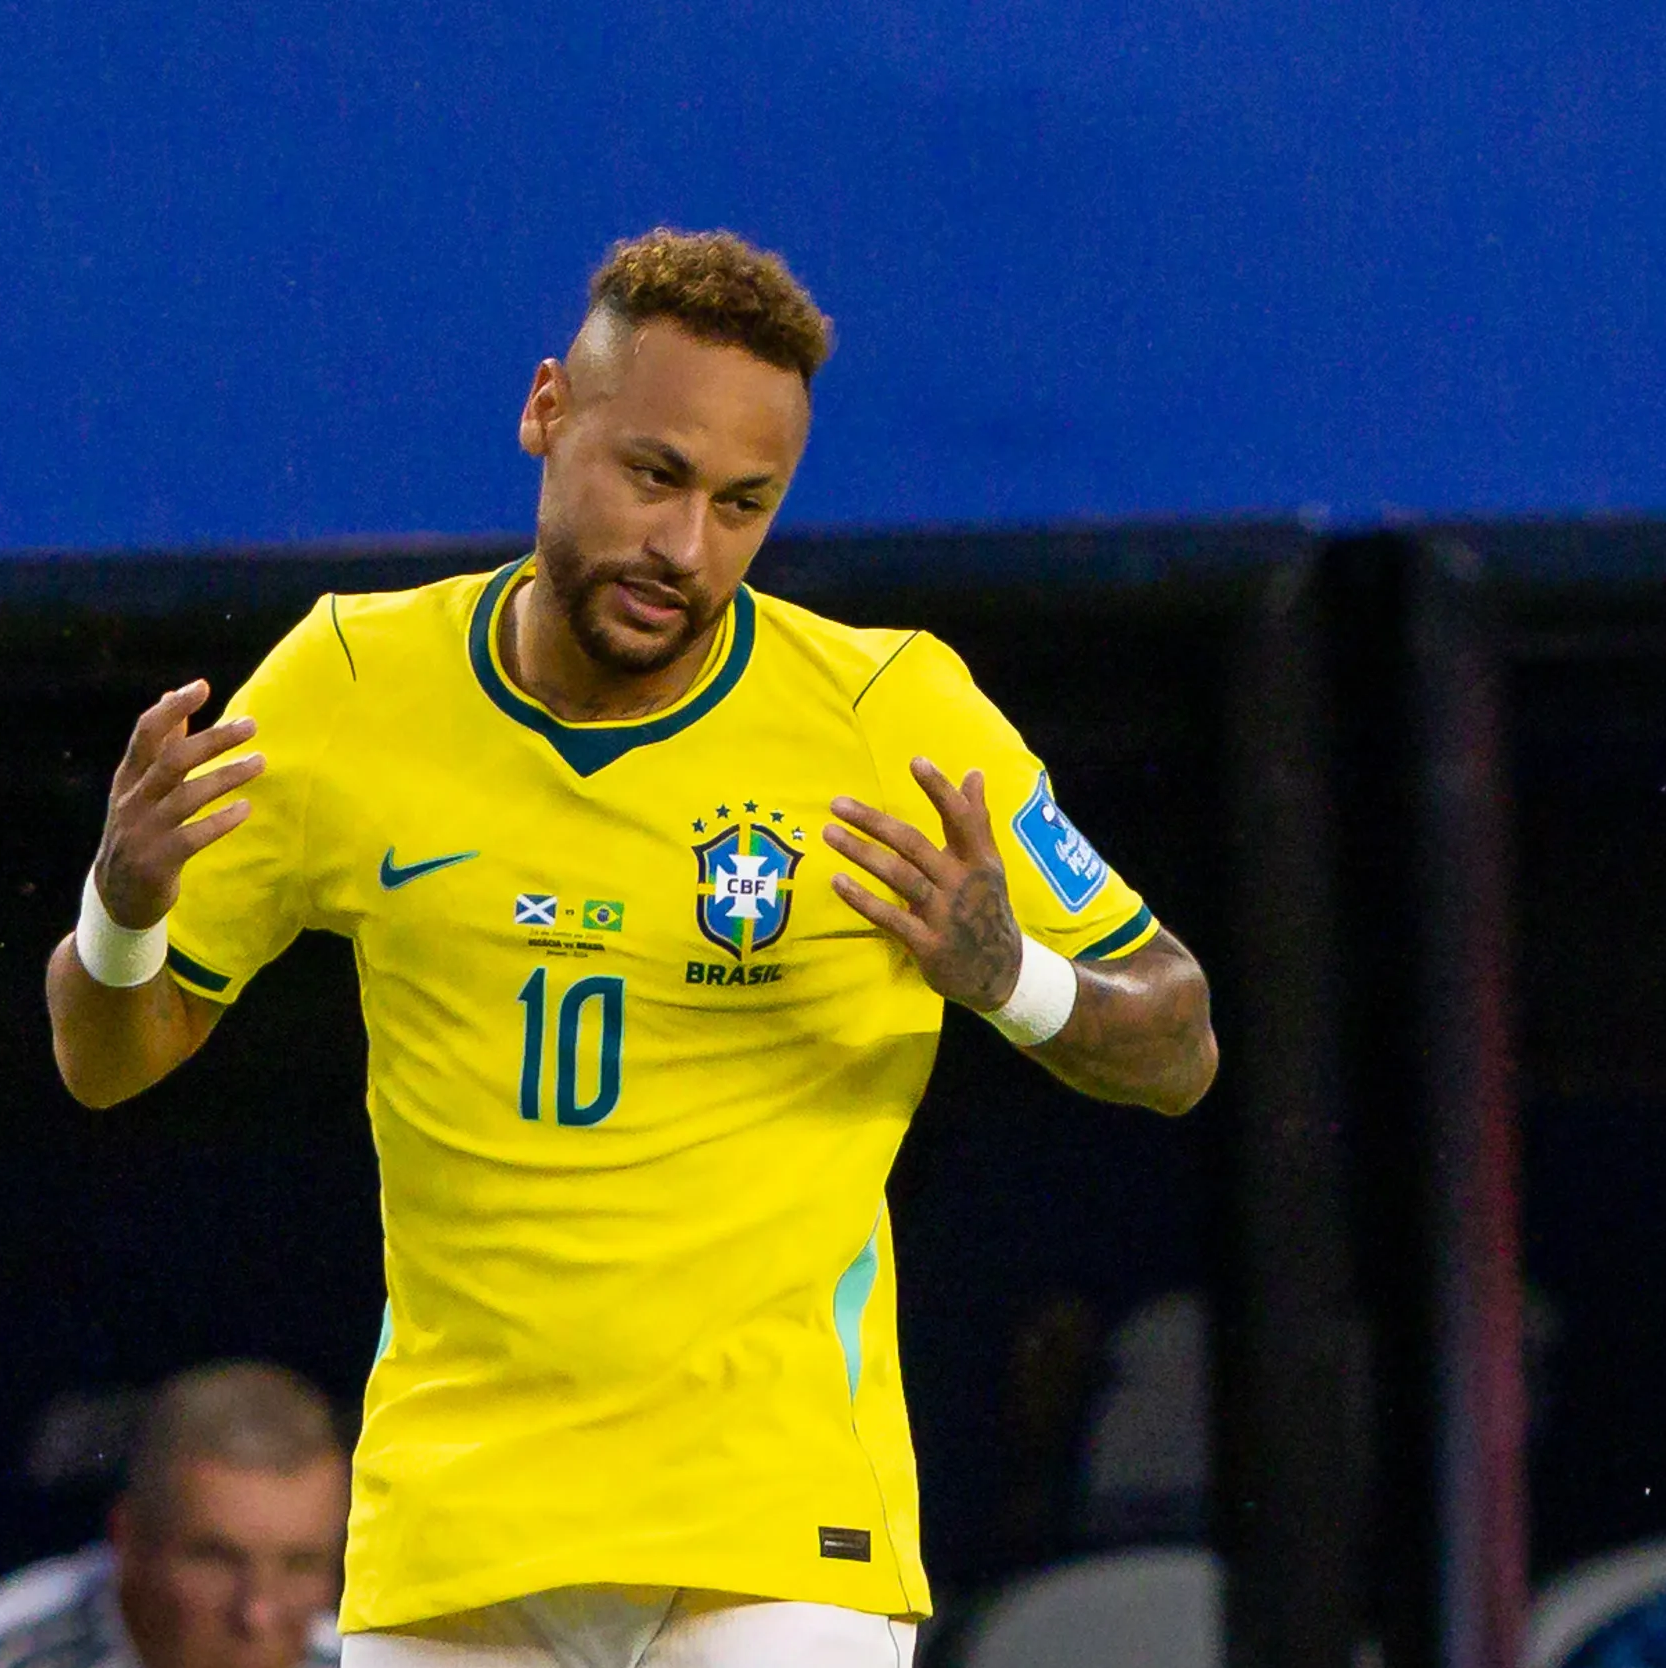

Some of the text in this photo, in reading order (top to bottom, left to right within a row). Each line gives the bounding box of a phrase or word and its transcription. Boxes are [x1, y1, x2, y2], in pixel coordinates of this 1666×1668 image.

[727, 878, 767, 896] CBF
[685, 961, 783, 986] BRASIL
[516, 965, 626, 1127] 10
